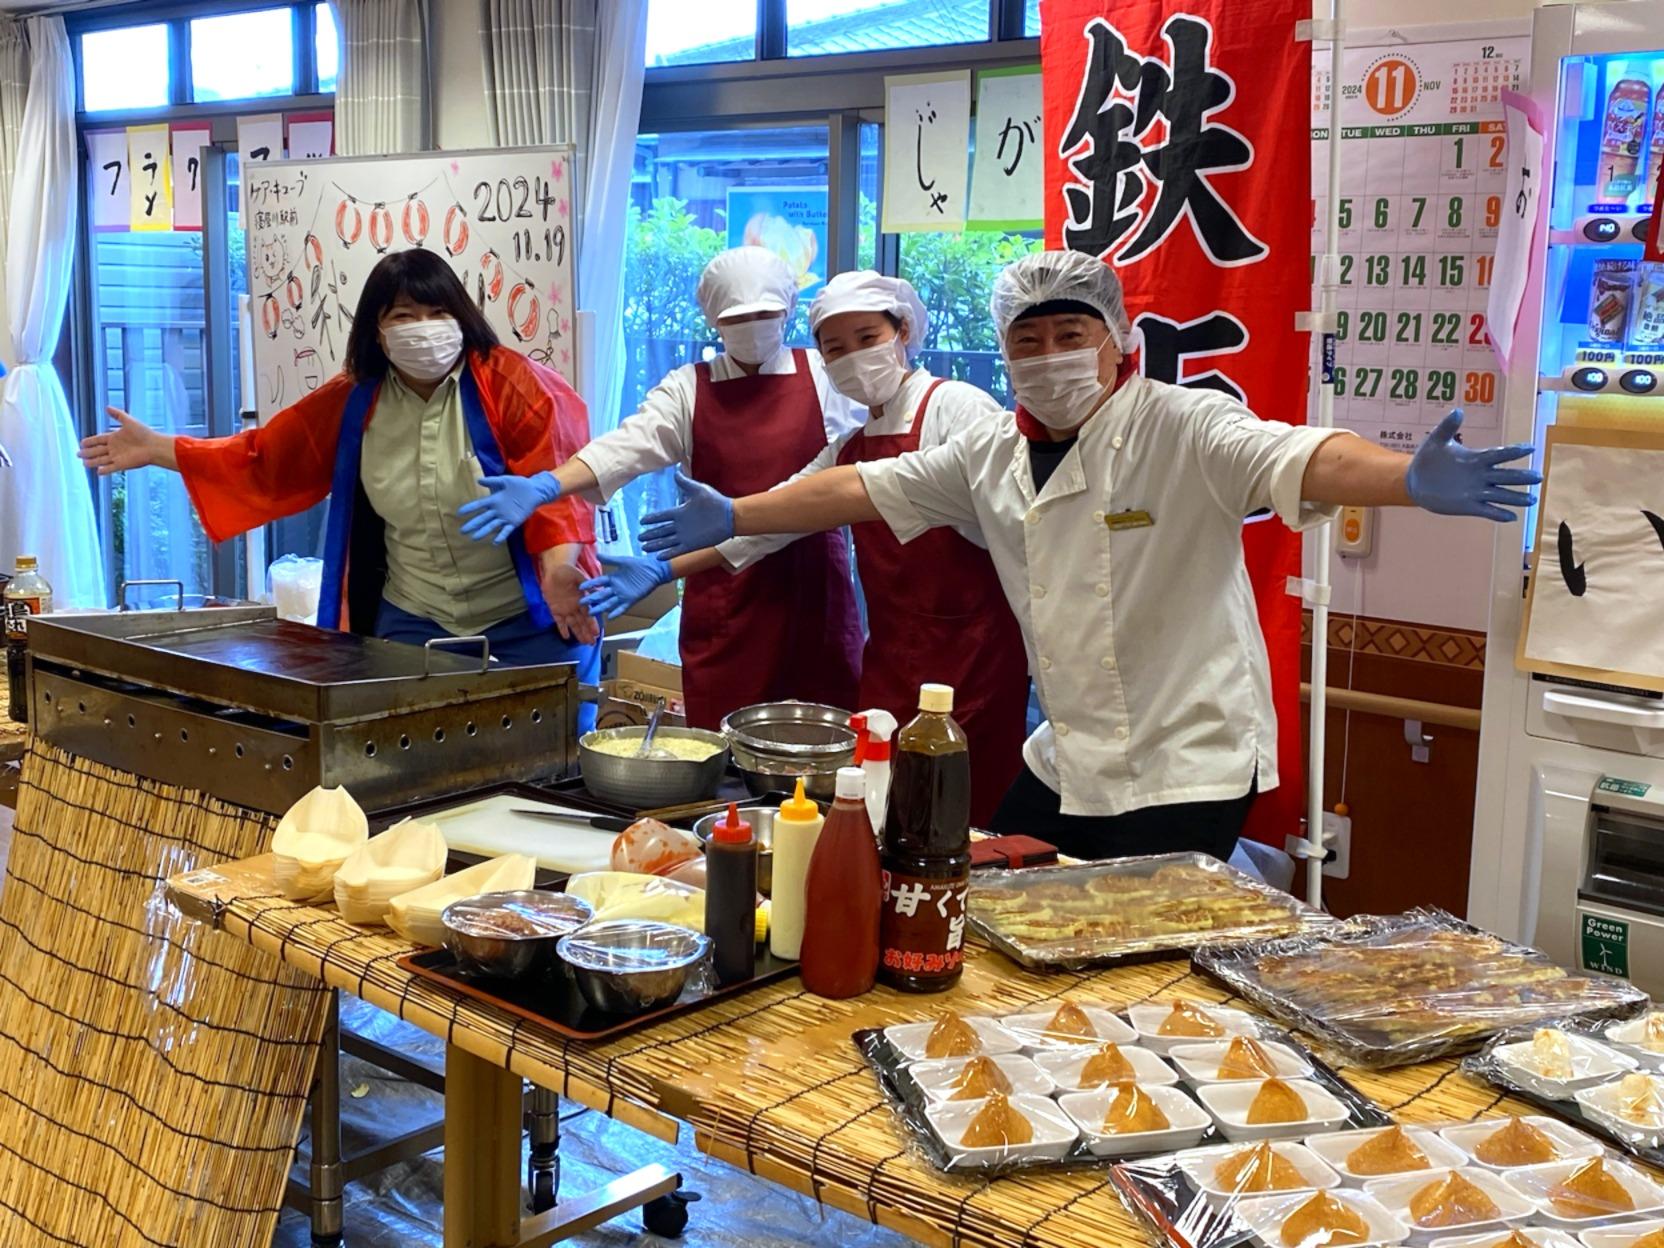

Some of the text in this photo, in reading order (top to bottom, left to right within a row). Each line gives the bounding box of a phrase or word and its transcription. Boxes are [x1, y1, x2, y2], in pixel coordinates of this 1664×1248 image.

[1481, 46, 1495, 59] 12
[1342, 65, 1441, 109] 2024 11 NOV
[996, 115, 1041, 176] が
[1312, 123, 1504, 138] ON TUE WED THU FRI SA
[914, 101, 948, 215] じゃ
[1454, 136, 1505, 168] 1 2
[103, 160, 121, 196] フ
[473, 175, 556, 222] 2024
[806, 210, 827, 218] Butte
[1338, 195, 1501, 229] 5 6 7 8 9
[512, 224, 566, 267] 11.19
[1340, 255, 1354, 285] 2
[1365, 255, 1390, 286] 13
[1401, 255, 1426, 286] 14
[1439, 255, 1465, 287] 15
[1337, 311, 1350, 341] 9
[1358, 311, 1387, 342] 20
[1396, 312, 1422, 342] 21
[1431, 312, 1461, 344] 22
[1334, 366, 1495, 404] 6 27 28 29 30
[1380, 430, 1413, 441] 株式会社
[1586, 926, 1624, 942] Power
[1587, 918, 1623, 934] Green
[1590, 961, 1623, 975] WIND
